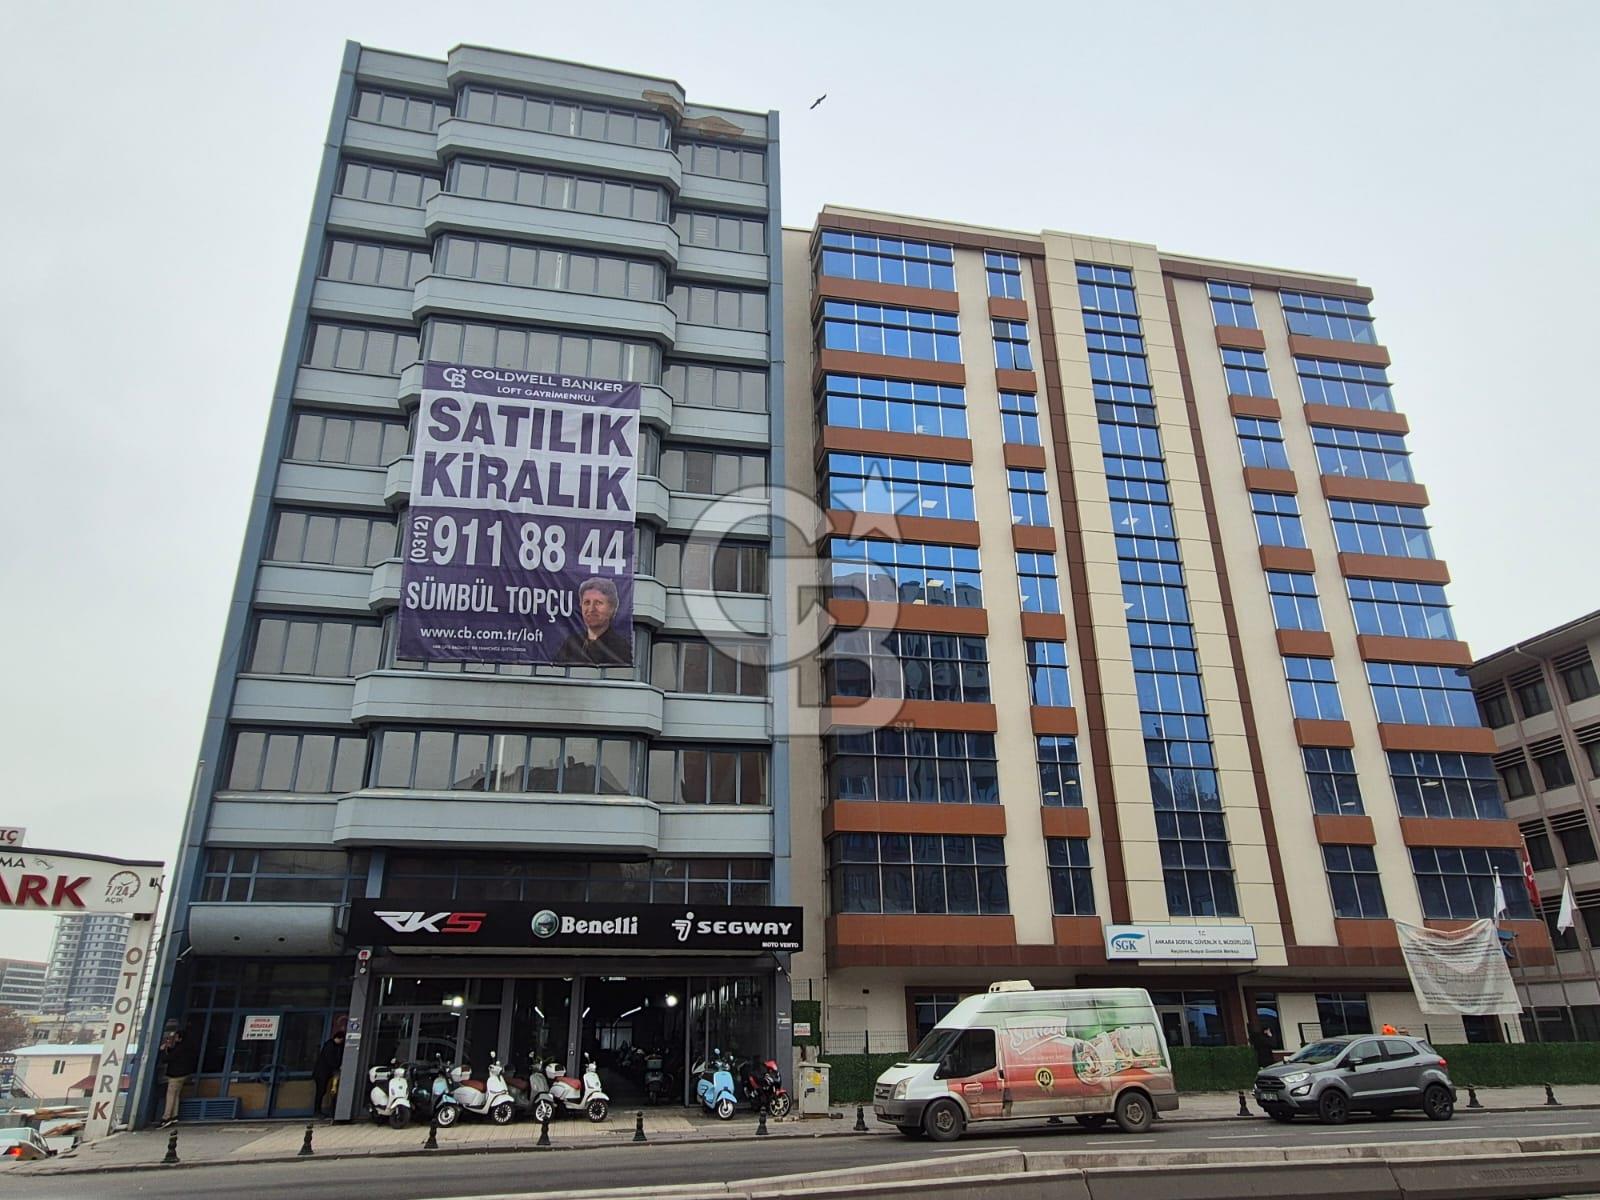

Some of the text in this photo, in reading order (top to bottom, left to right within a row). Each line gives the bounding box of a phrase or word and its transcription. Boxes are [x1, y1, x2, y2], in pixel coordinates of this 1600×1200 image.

[471, 369, 623, 393] COLDWELL BANKER
[497, 386, 596, 403] LOFT GAYRİMENKUL
[428, 397, 633, 458] SATILIK
[410, 515, 626, 575] (0312) 911 88 44
[406, 576, 573, 623] SÜMBÜL TOPÇU
[420, 626, 543, 642] www.cb.com.tr/loft
[105, 885, 129, 896] 7/24
[373, 911, 487, 933] RKS
[561, 916, 638, 935] Benelli
[697, 921, 792, 935] SEGWAY
[1115, 940, 1137, 951] SGK
[92, 946, 143, 1121] OTOPARK
